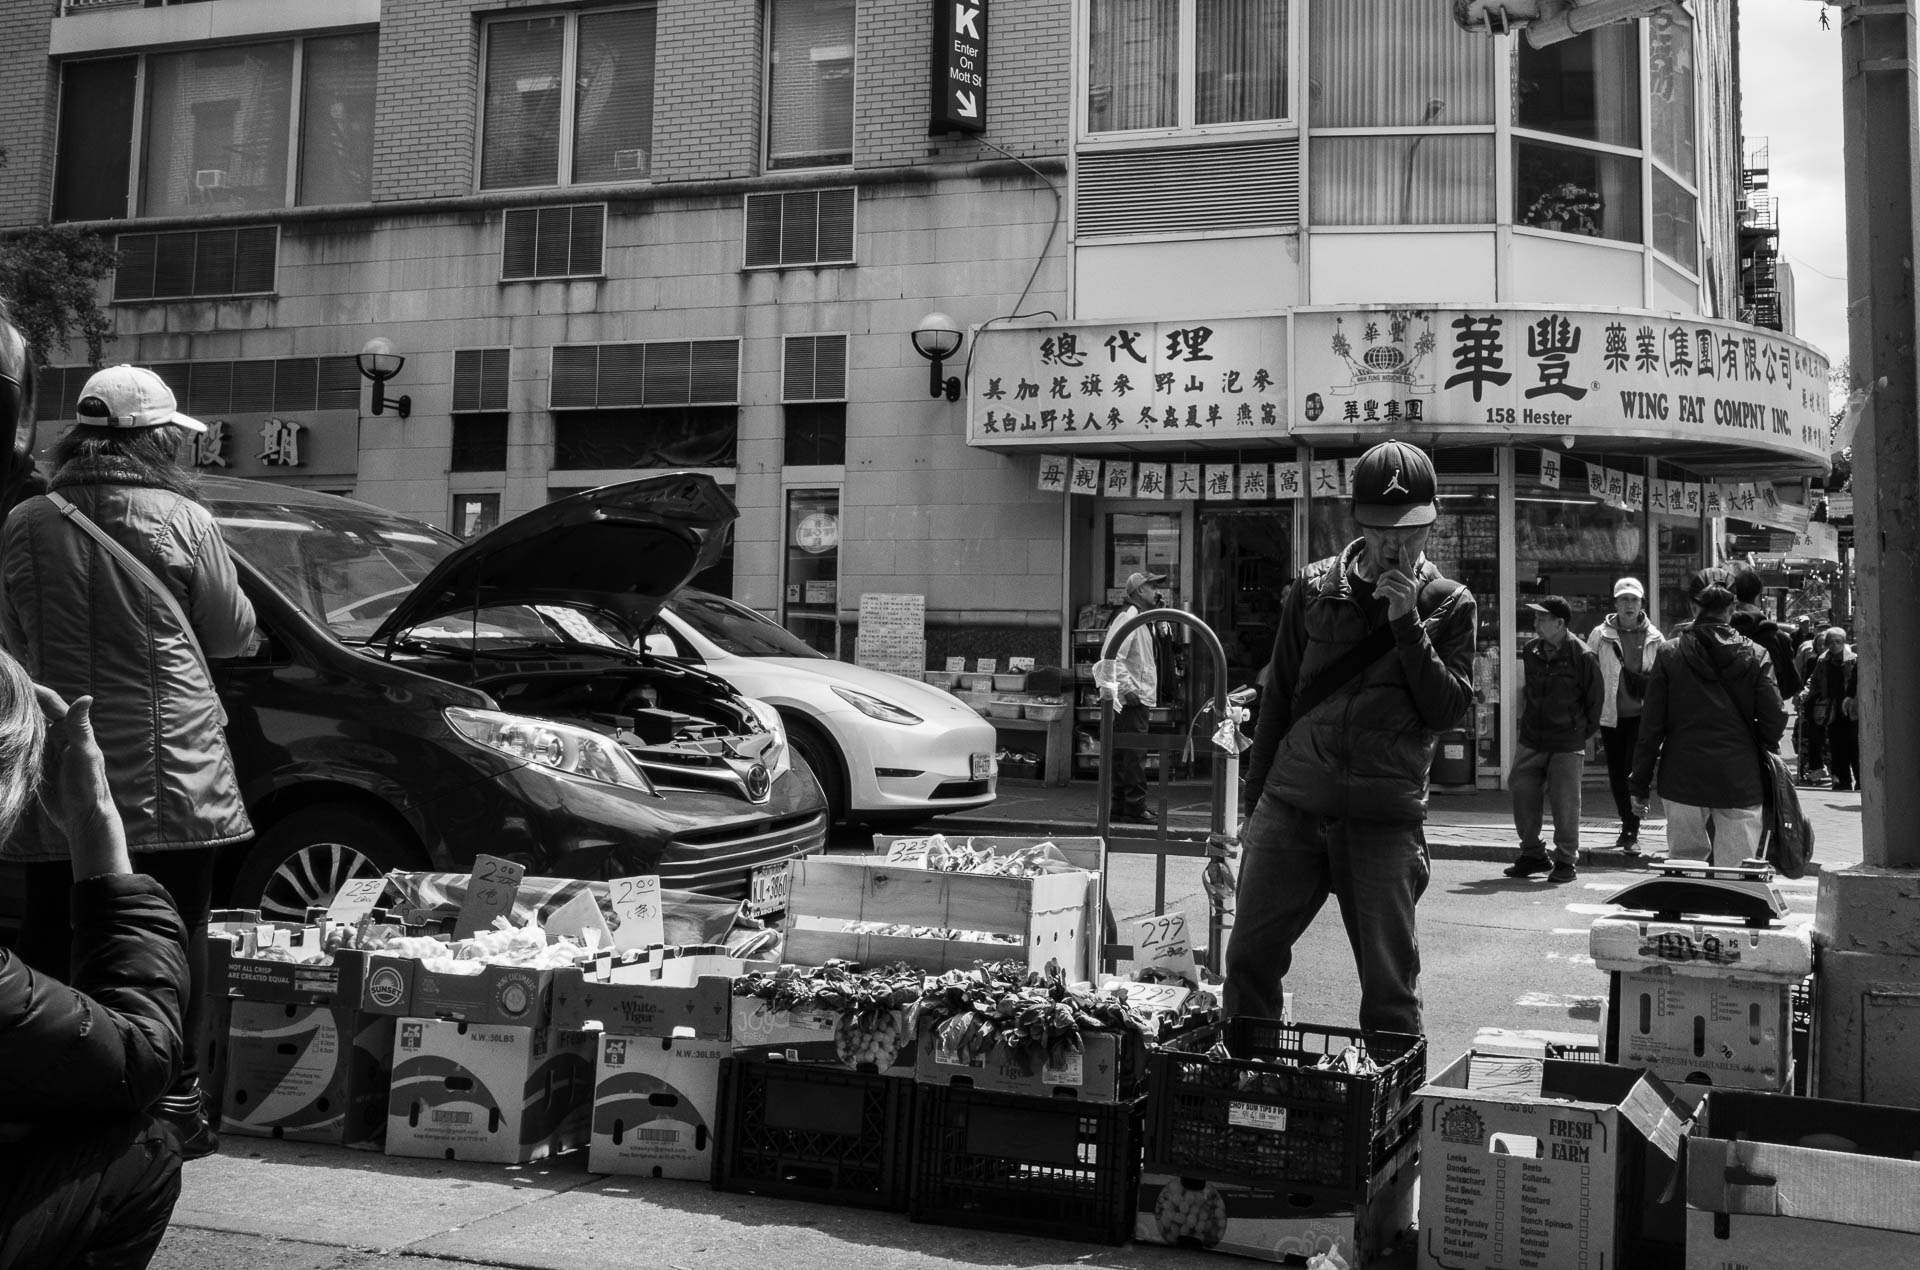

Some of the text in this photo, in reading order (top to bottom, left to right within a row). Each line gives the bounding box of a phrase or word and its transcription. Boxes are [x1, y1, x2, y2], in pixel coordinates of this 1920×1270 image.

[956, 0, 980, 40] K
[955, 40, 978, 57] Enter
[960, 57, 973, 70] On
[950, 67, 982, 87] Mott St
[1040, 326, 1214, 368] 總代理
[1444, 313, 1588, 403] 華豐
[1603, 321, 1792, 391] 藥業(集團)有限公司
[982, 368, 1275, 400] 美加花旗參 野山泡參
[983, 407, 1124, 434] 長白山野生人參
[1140, 403, 1223, 430] 冬蟲夏草
[1236, 402, 1277, 426] 燕窩
[1343, 400, 1423, 423] 華豐集團
[1486, 408, 1572, 425] 158 Hester
[1620, 391, 1792, 436] WING FAT COMPNY INC.
[1041, 465, 1357, 496] 母親節獻大禮燕窩大
[1141, 916, 1184, 948] 299
[1729, 939, 1738, 948] 54
[228, 963, 272, 974] NOT ALL CRISP
[228, 971, 290, 984] ARE CREATED EQUAL
[371, 986, 402, 996] SUNSET
[621, 1000, 657, 1014] White
[625, 1011, 655, 1025] Tiger
[1661, 1056, 1740, 1071] FRESH VEGETABLES
[1550, 1119, 1593, 1140] FRESH
[1447, 1153, 1467, 1163] Leeks
[1552, 1143, 1590, 1163] FARM
[1446, 1163, 1481, 1175] Dandelion
[1522, 1162, 1542, 1173] Beets
[1522, 1173, 1551, 1184] Collards
[1522, 1184, 1537, 1193] Kale
[1521, 1194, 1550, 1206] Mustard
[1445, 1205, 1467, 1215] Endive
[1444, 1215, 1489, 1230] Curly Parsley
[1520, 1215, 1573, 1230] Bunch Spinach
[1444, 1226, 1488, 1240] Plain Parsley
[1520, 1226, 1549, 1238] Spinach
[1444, 1237, 1474, 1249] Red Leaf
[1443, 1247, 1480, 1260] Green Leaf
